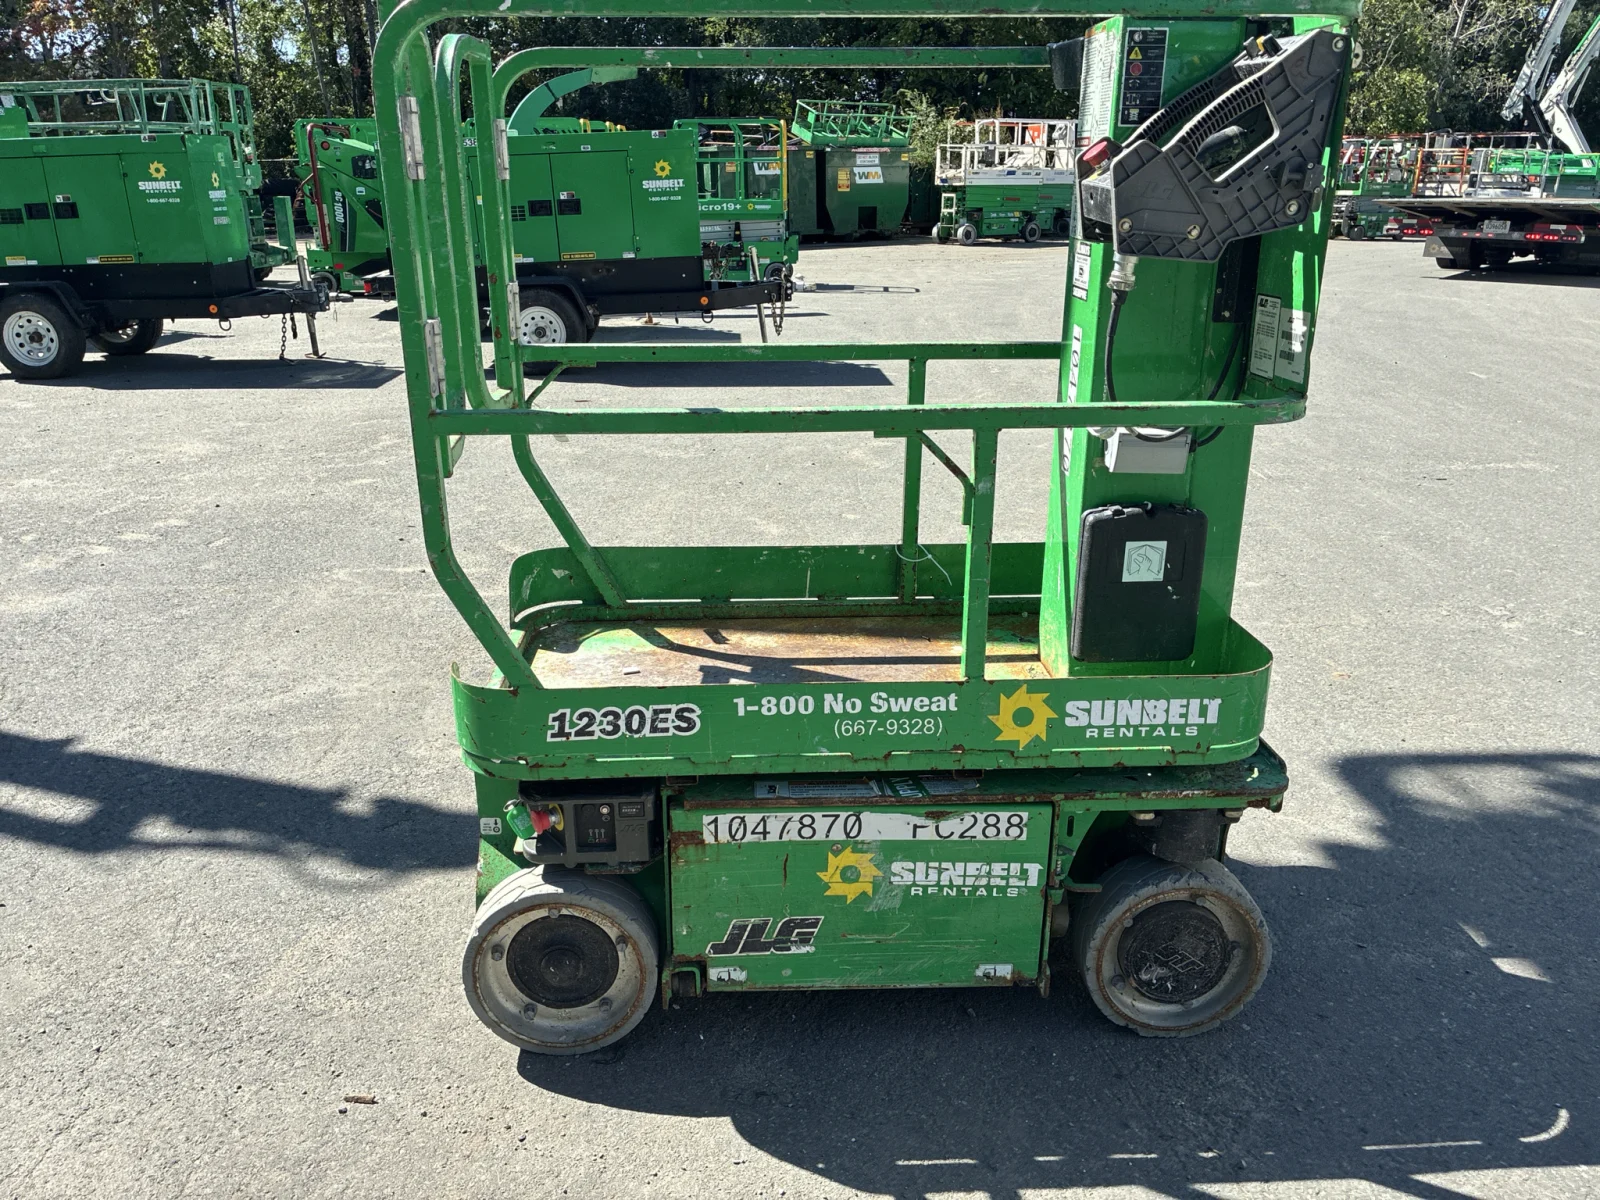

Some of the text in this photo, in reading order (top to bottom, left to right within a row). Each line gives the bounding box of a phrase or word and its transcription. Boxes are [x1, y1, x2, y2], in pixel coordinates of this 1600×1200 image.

[138, 181, 182, 190] SUNBELT
[642, 179, 684, 189] SUNBELT
[857, 171, 880, 180] WM
[698, 202, 742, 211] icro19+
[733, 691, 958, 717] 1-800 No Sweat
[1064, 697, 1222, 727] SUNBELT
[547, 703, 701, 741] 1230ES
[834, 716, 944, 739] (667-9328)
[1085, 726, 1199, 738] RENTALS
[706, 812, 863, 843] 1047870
[889, 861, 1044, 887] SUNBELT
[910, 886, 1020, 898] RENTALS
[705, 916, 825, 957] JLG
